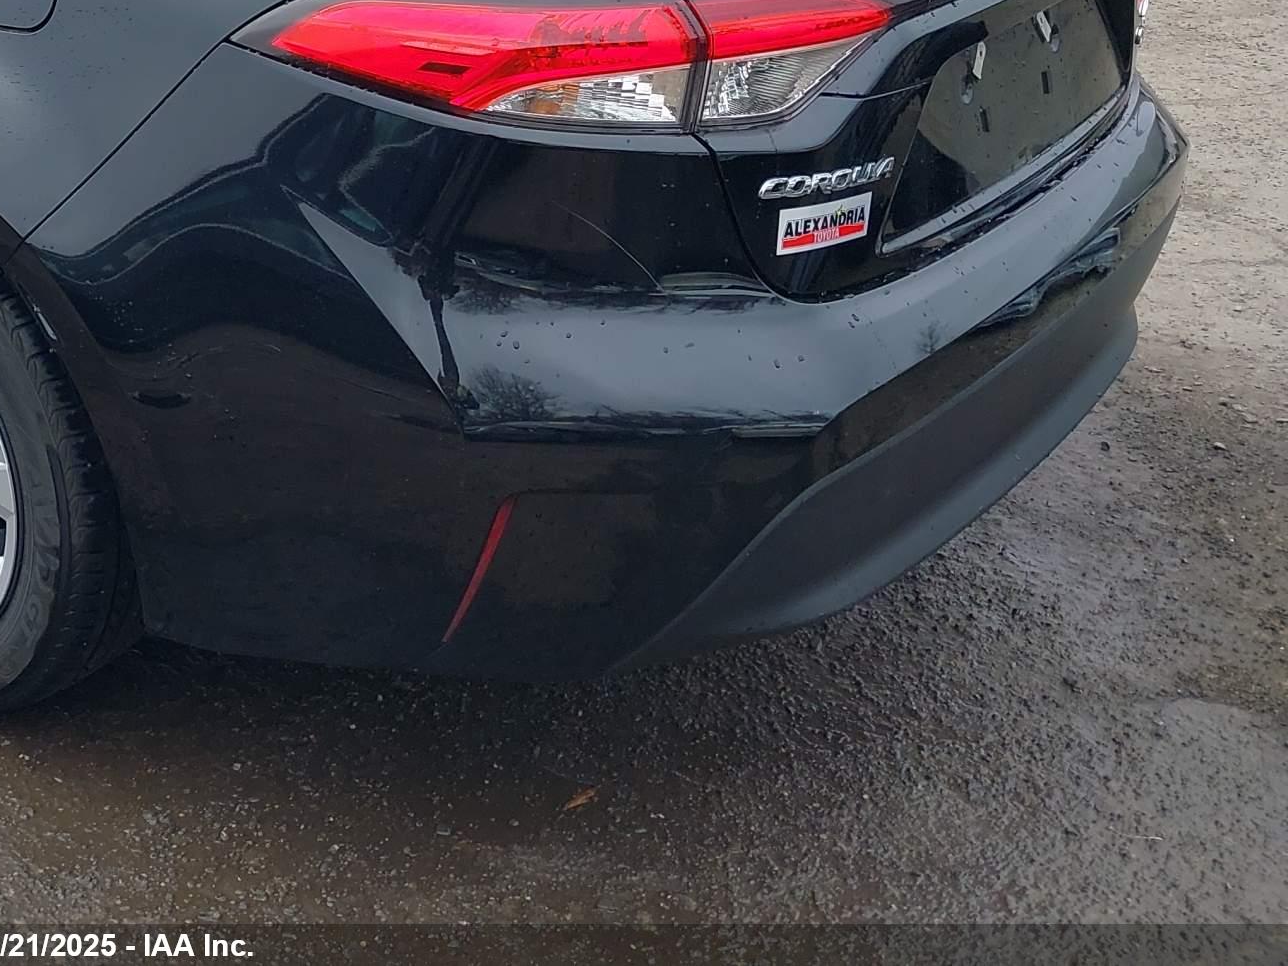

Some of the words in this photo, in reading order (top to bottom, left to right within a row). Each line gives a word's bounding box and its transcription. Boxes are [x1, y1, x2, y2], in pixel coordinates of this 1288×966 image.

[758, 156, 895, 201] COROLLA
[783, 205, 866, 238] ALEXANDRIA
[812, 227, 841, 244] TOYOTA
